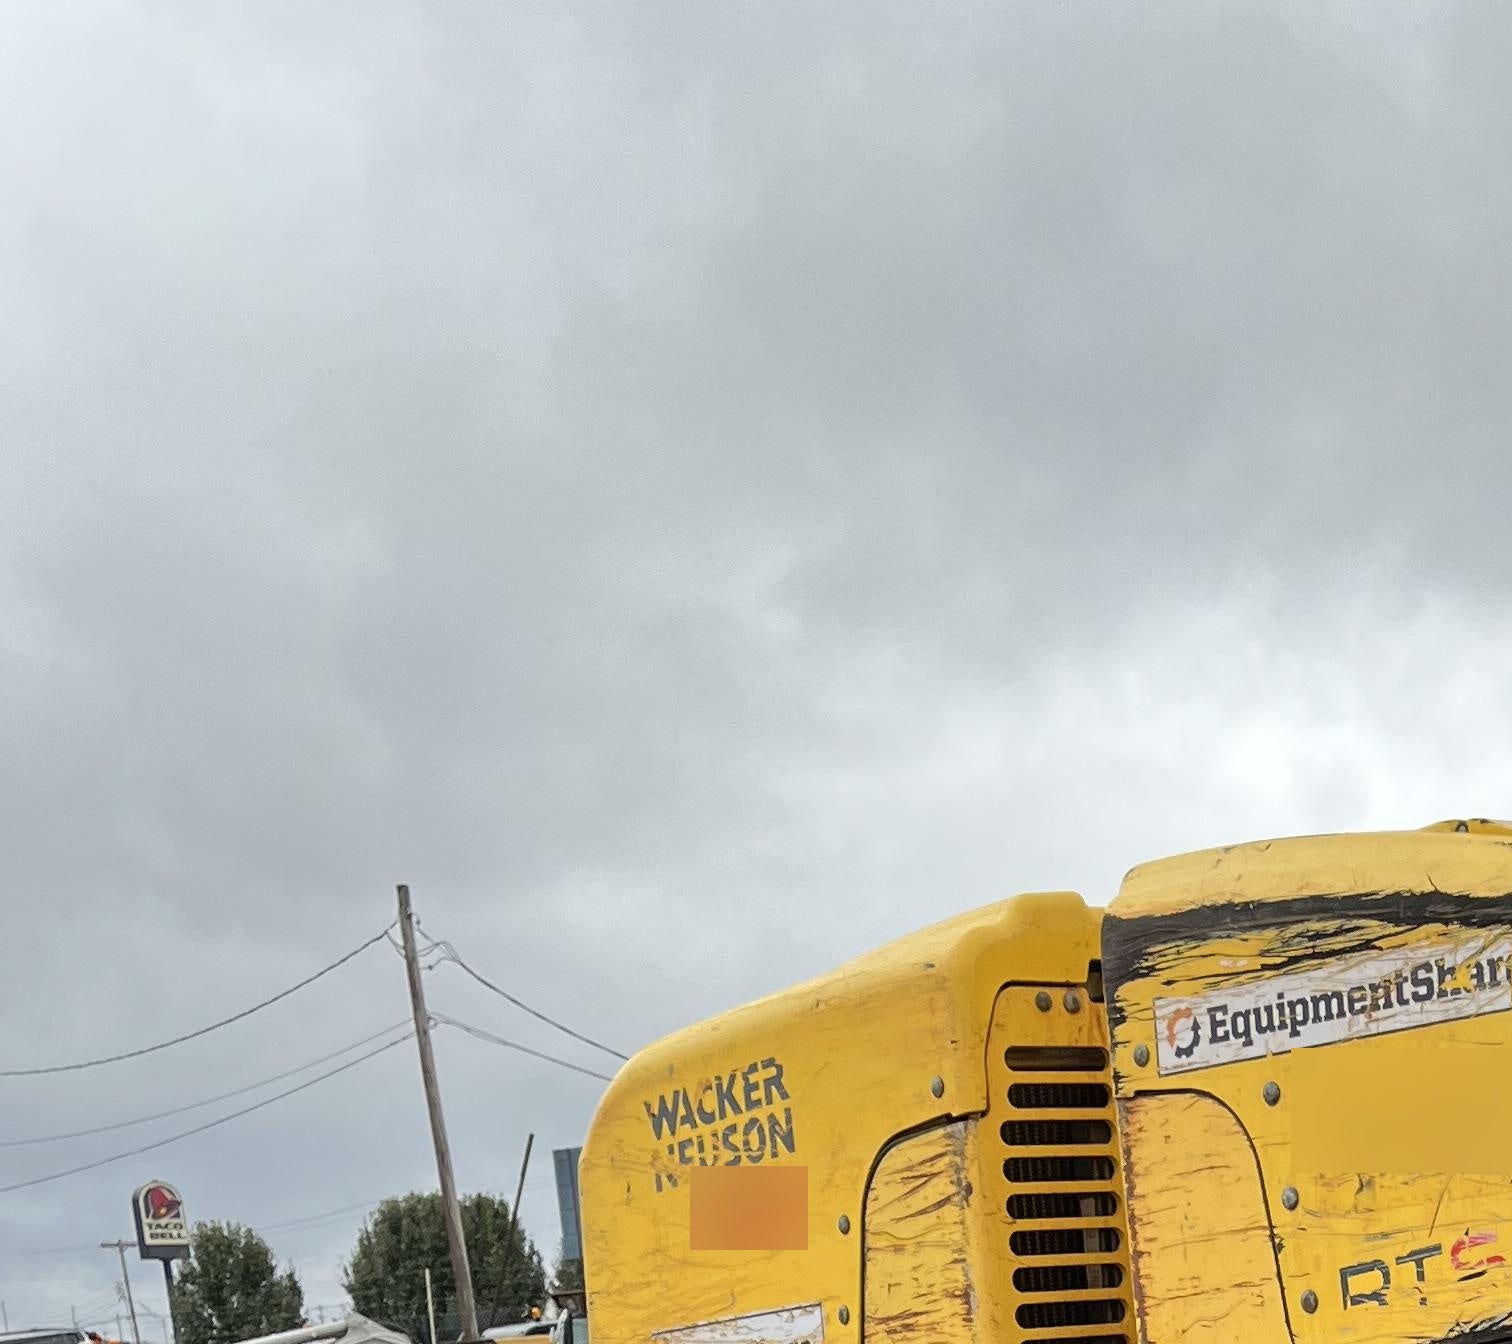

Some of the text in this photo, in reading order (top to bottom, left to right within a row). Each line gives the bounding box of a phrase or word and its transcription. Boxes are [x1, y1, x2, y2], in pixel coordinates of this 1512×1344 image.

[643, 1056, 791, 1141] WACKER
[147, 1222, 183, 1230] TACO
[149, 1231, 185, 1240] BELL
